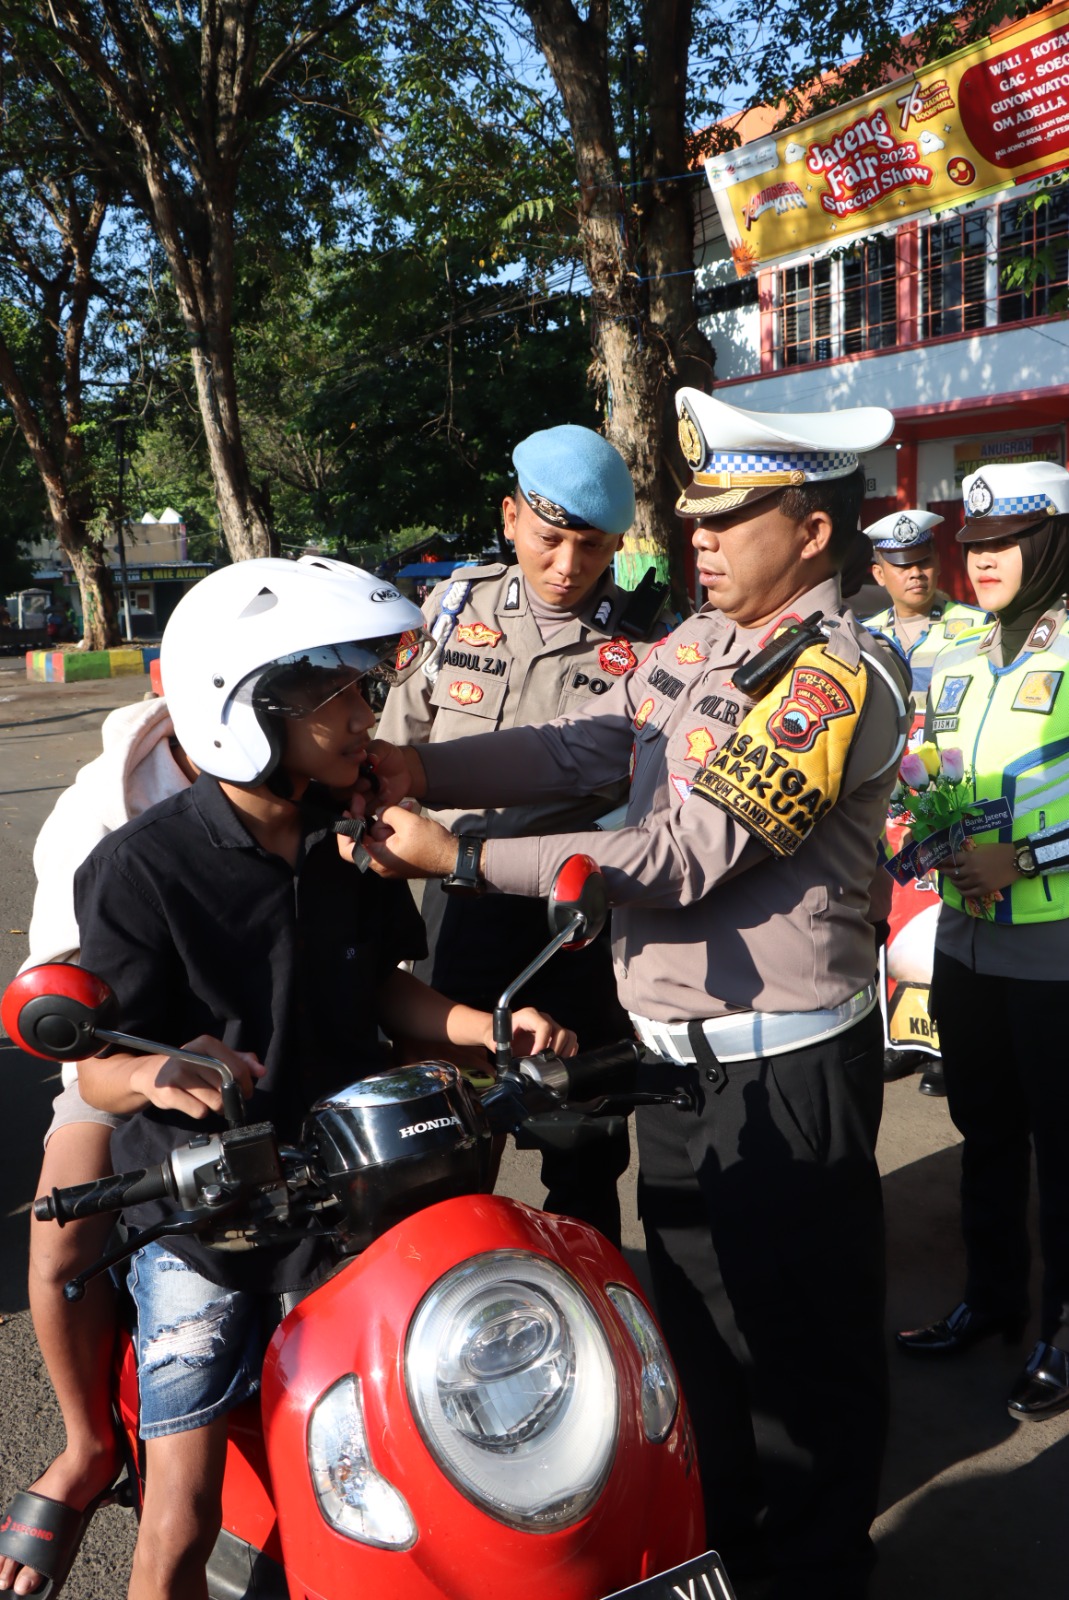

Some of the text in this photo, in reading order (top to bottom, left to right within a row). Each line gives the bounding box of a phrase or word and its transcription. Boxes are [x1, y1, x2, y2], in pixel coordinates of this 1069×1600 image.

[989, 54, 1022, 76] WALI
[999, 72, 1026, 91] GAC
[991, 74, 1069, 114] GUYON WATO
[993, 95, 1067, 132] OM ADELLA
[1017, 117, 1056, 138] REBELLION
[809, 112, 894, 170] Jateng
[827, 145, 916, 197] Fair 2023
[823, 167, 929, 214] Special Show
[981, 440, 1033, 457] ANUGRAH
[153, 568, 174, 579] MIE
[176, 567, 207, 578] AYAM
[444, 649, 507, 677] ABDUL Z.N
[572, 672, 614, 695] PO
[799, 673, 844, 708] POLRESTA
[934, 720, 955, 729] RISMA
[710, 752, 815, 836] AKKUM
[733, 793, 771, 828] CANDI
[965, 809, 1009, 827] Bank Jateng
[920, 841, 950, 865] Bank Jaten
[901, 862, 912, 871] Ba
[399, 1116, 462, 1139] HONDA
